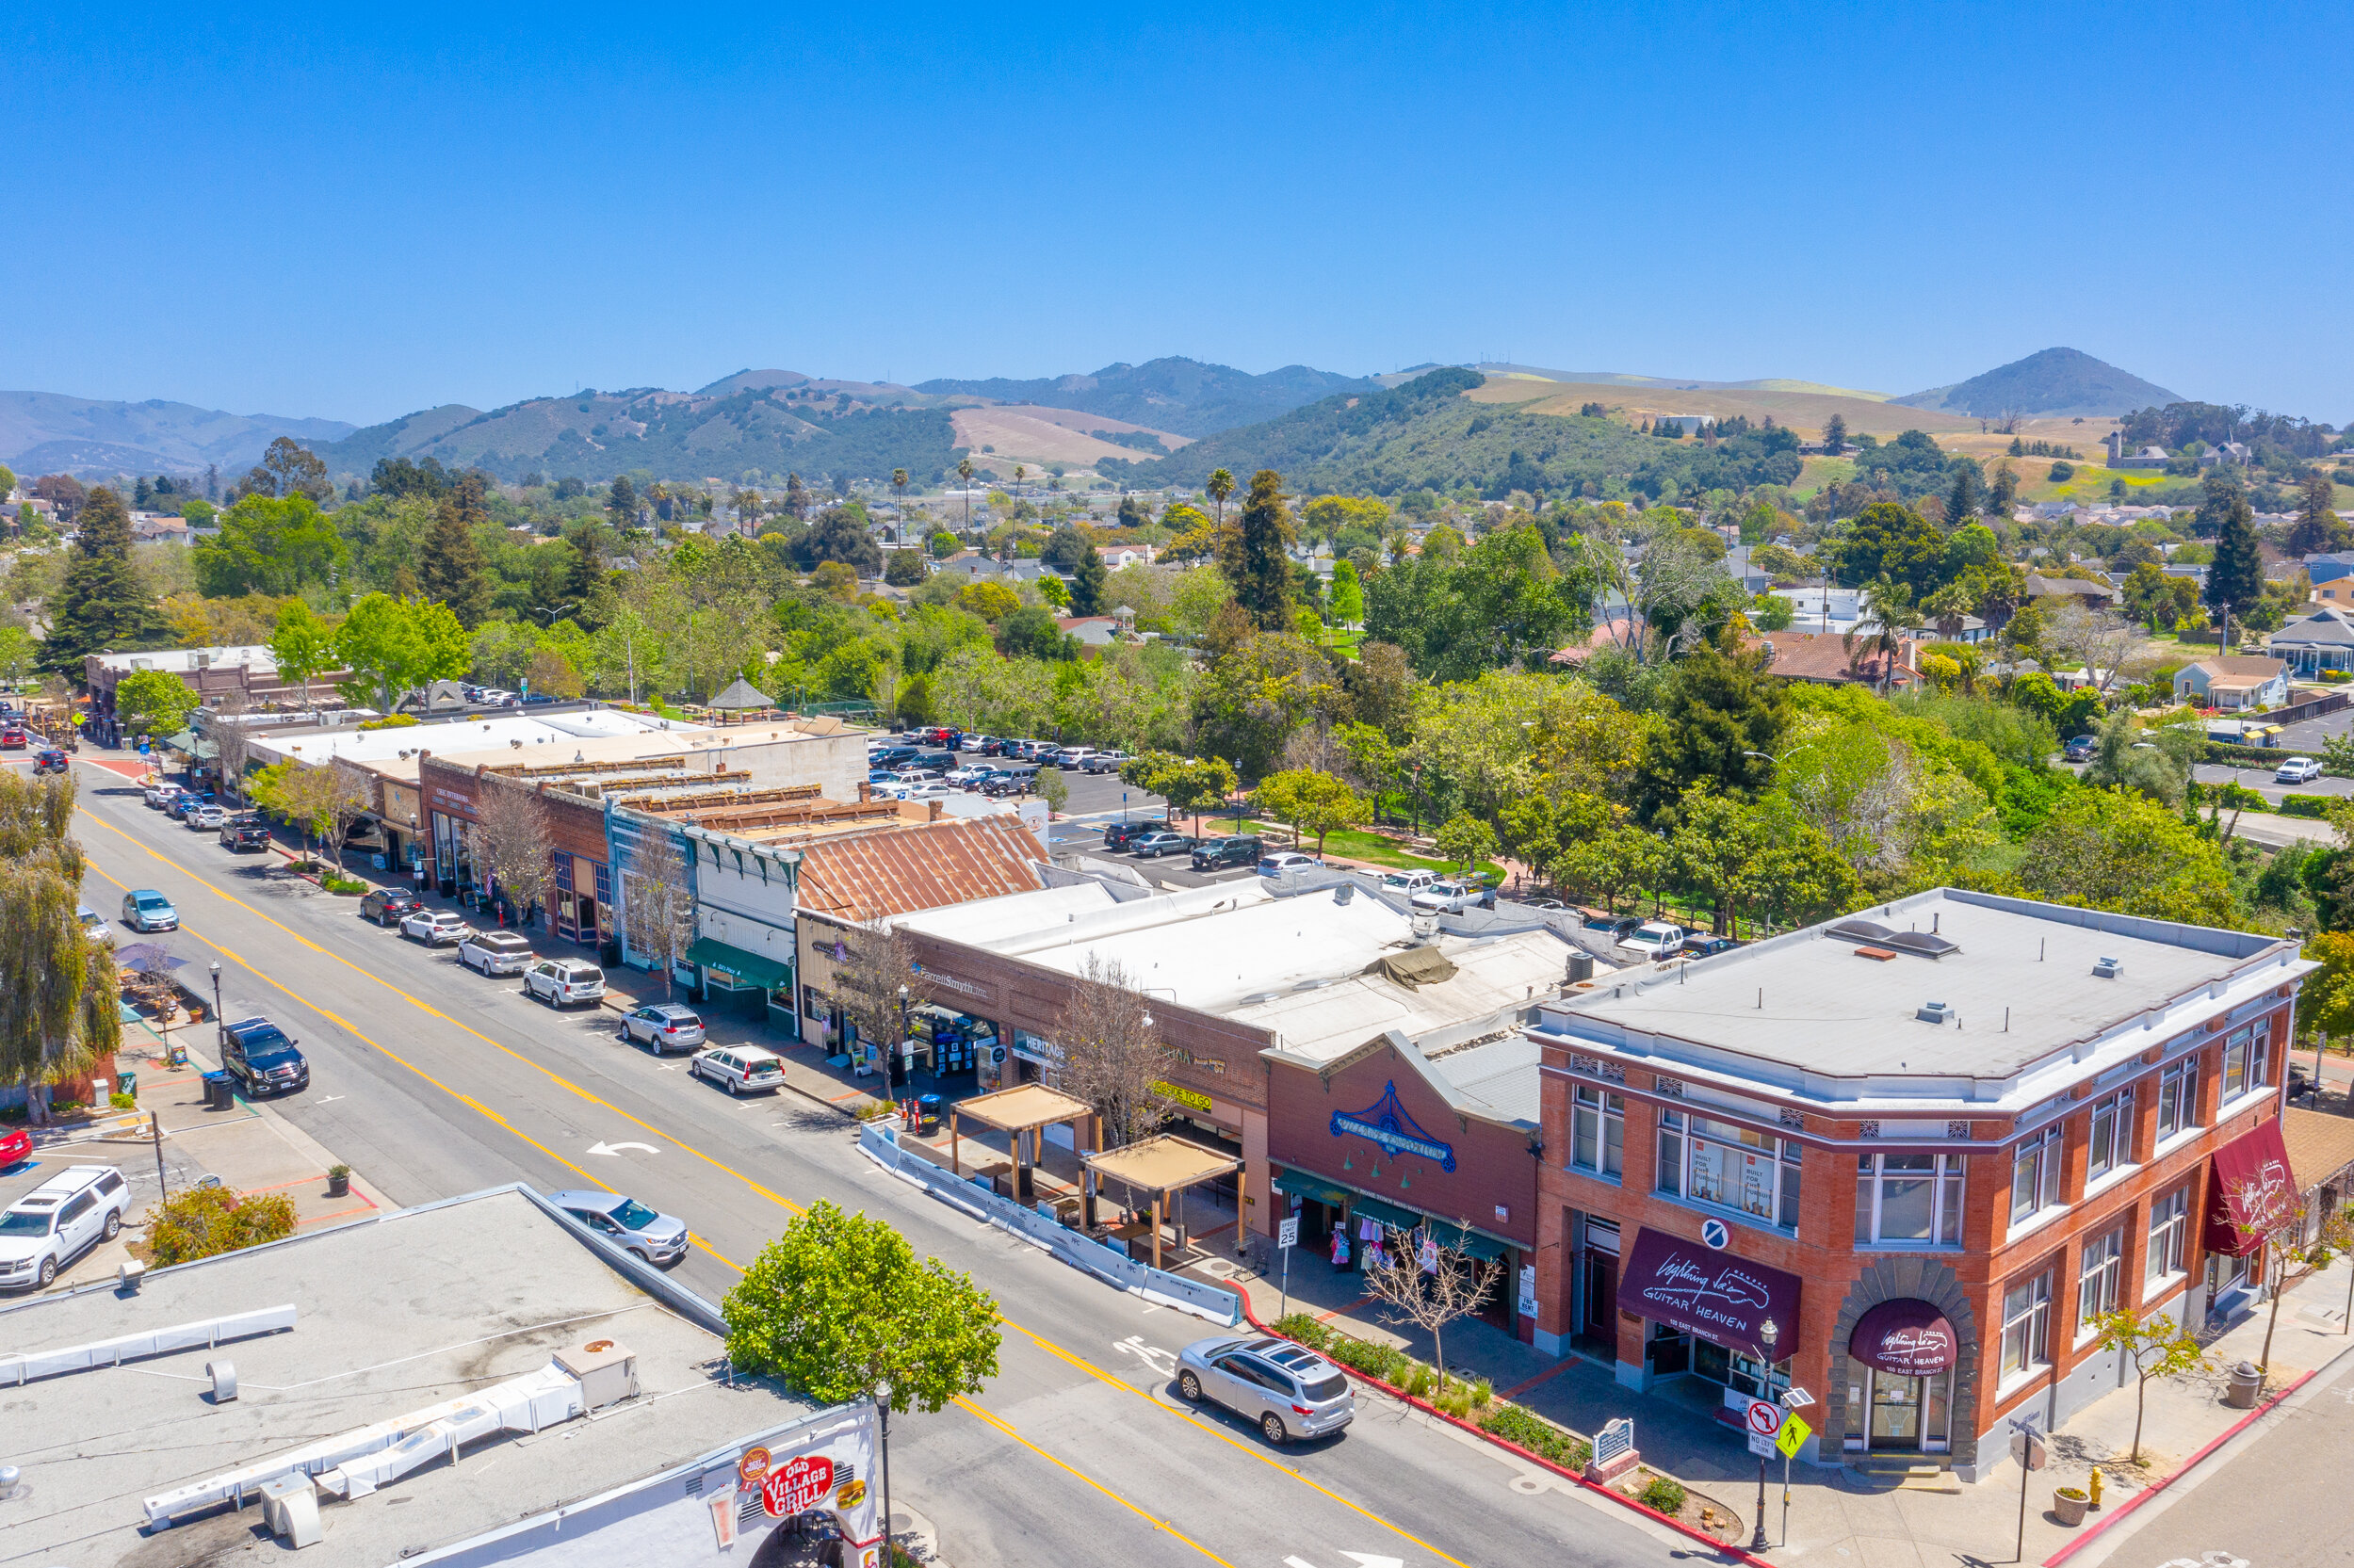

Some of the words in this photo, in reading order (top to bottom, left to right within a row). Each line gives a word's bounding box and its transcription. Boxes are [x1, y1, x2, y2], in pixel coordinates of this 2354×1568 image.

[1026, 1035, 1065, 1059] HERITAGE
[1184, 1091, 1196, 1103] TO
[1197, 1095, 1210, 1107] GO
[1339, 1119, 1383, 1140] VILLAGE
[1386, 1133, 1444, 1160] EMPORIUM
[1696, 1154, 1712, 1163] BUILT
[1745, 1168, 1763, 1178] BUILT
[1359, 1188, 1376, 1199] HOME
[1376, 1193, 1393, 1204] TOWN
[1393, 1199, 1423, 1216] MINI-MALL
[1281, 1220, 1297, 1229] SPEED
[1280, 1232, 1295, 1245] 25
[1656, 1252, 1709, 1304] Lightning
[1521, 1302, 1534, 1312] RENT
[1523, 1297, 1534, 1305] FOR
[1643, 1286, 1690, 1312] GUITAR
[1696, 1305, 1748, 1332] HEAVEN
[1679, 1321, 1692, 1332] EAST
[1692, 1325, 1713, 1339] BRANCH
[1880, 1329, 1916, 1359] Lightning
[1876, 1353, 1910, 1365] GUITAR
[1914, 1356, 1944, 1366] HEAVEN
[1914, 1367, 1938, 1376] BRANCH
[1751, 1435, 1760, 1444] NO
[1761, 1438, 1774, 1449] LEFT
[1755, 1444, 1769, 1454] TURN
[786, 1461, 810, 1479] OLD
[766, 1466, 828, 1503] VILLAGE
[773, 1483, 824, 1516] GRILL
